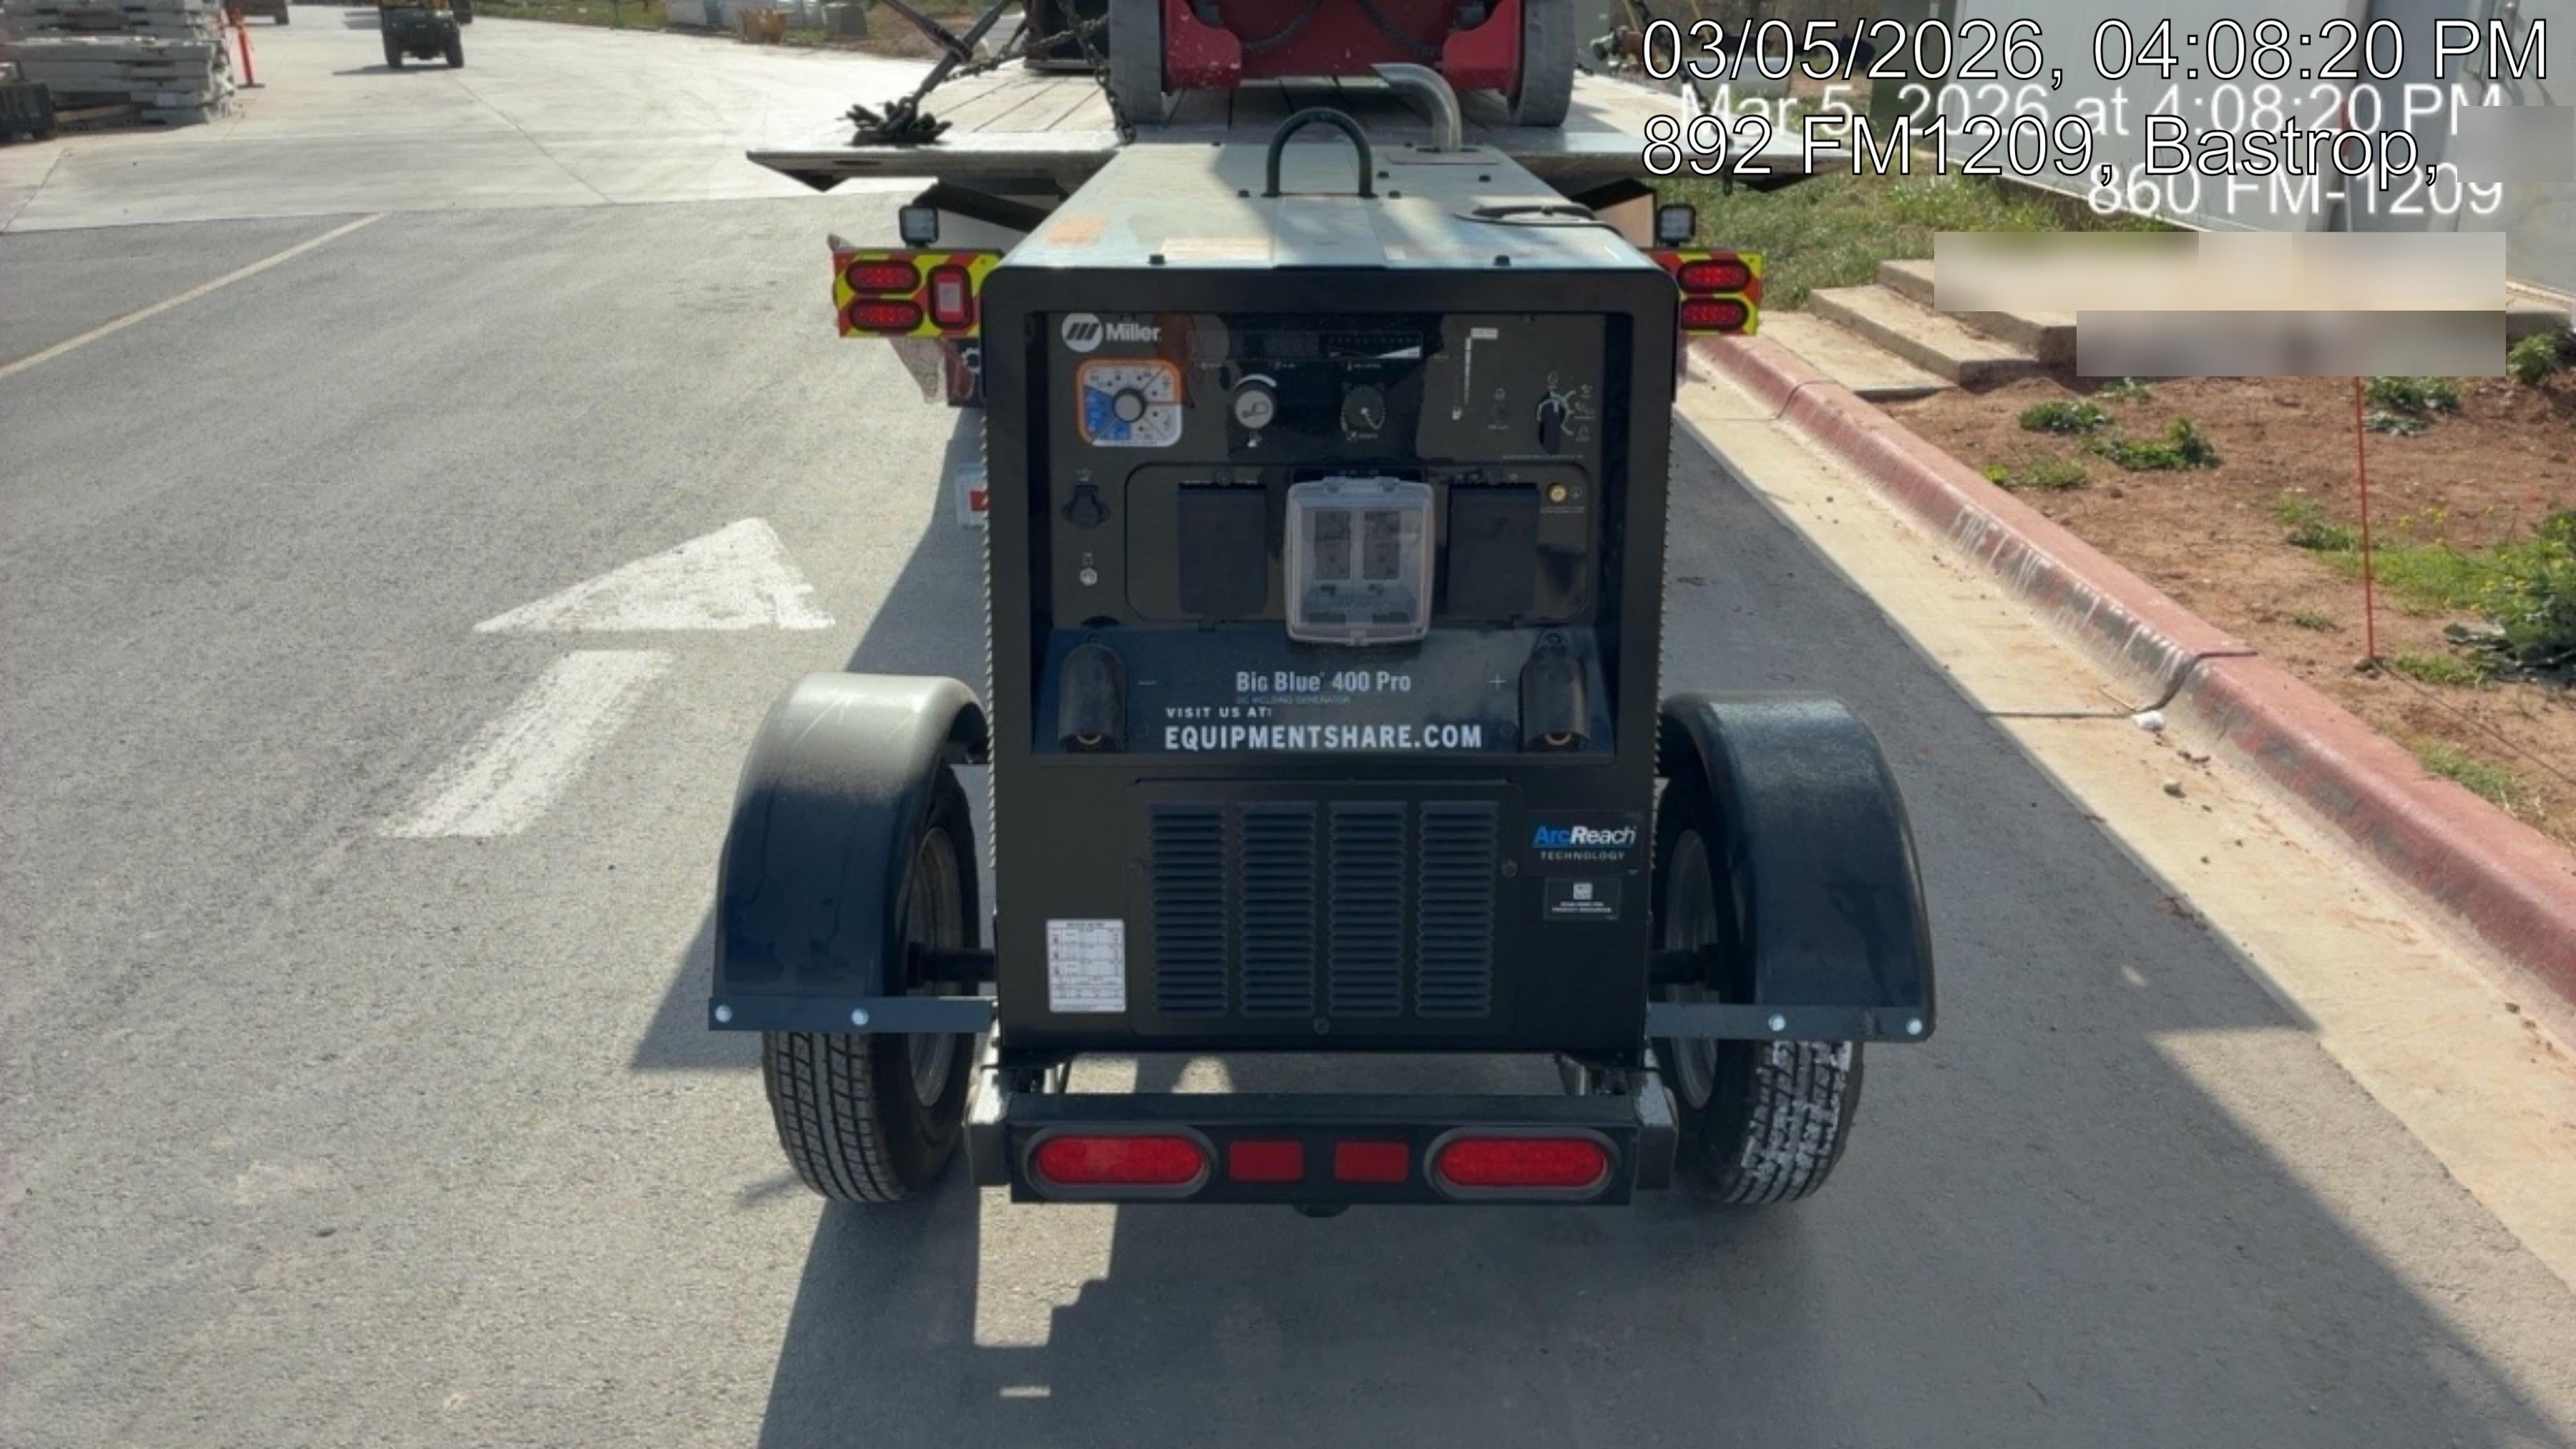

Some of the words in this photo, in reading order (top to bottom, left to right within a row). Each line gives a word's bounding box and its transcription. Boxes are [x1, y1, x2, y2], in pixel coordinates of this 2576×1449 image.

[1106, 323, 1162, 341] Miller
[1236, 671, 1269, 692] Big
[1332, 671, 1370, 692] 400
[1376, 671, 1412, 692] Pro
[1165, 706, 1211, 718] VISIT
[1218, 706, 1240, 718] US
[1246, 706, 1272, 718] AT:
[1164, 724, 1483, 751] EQUIPMENTSHARE.COM
[1533, 825, 1637, 845] ArcReach
[1540, 851, 1626, 861] TECHNOLOGY
